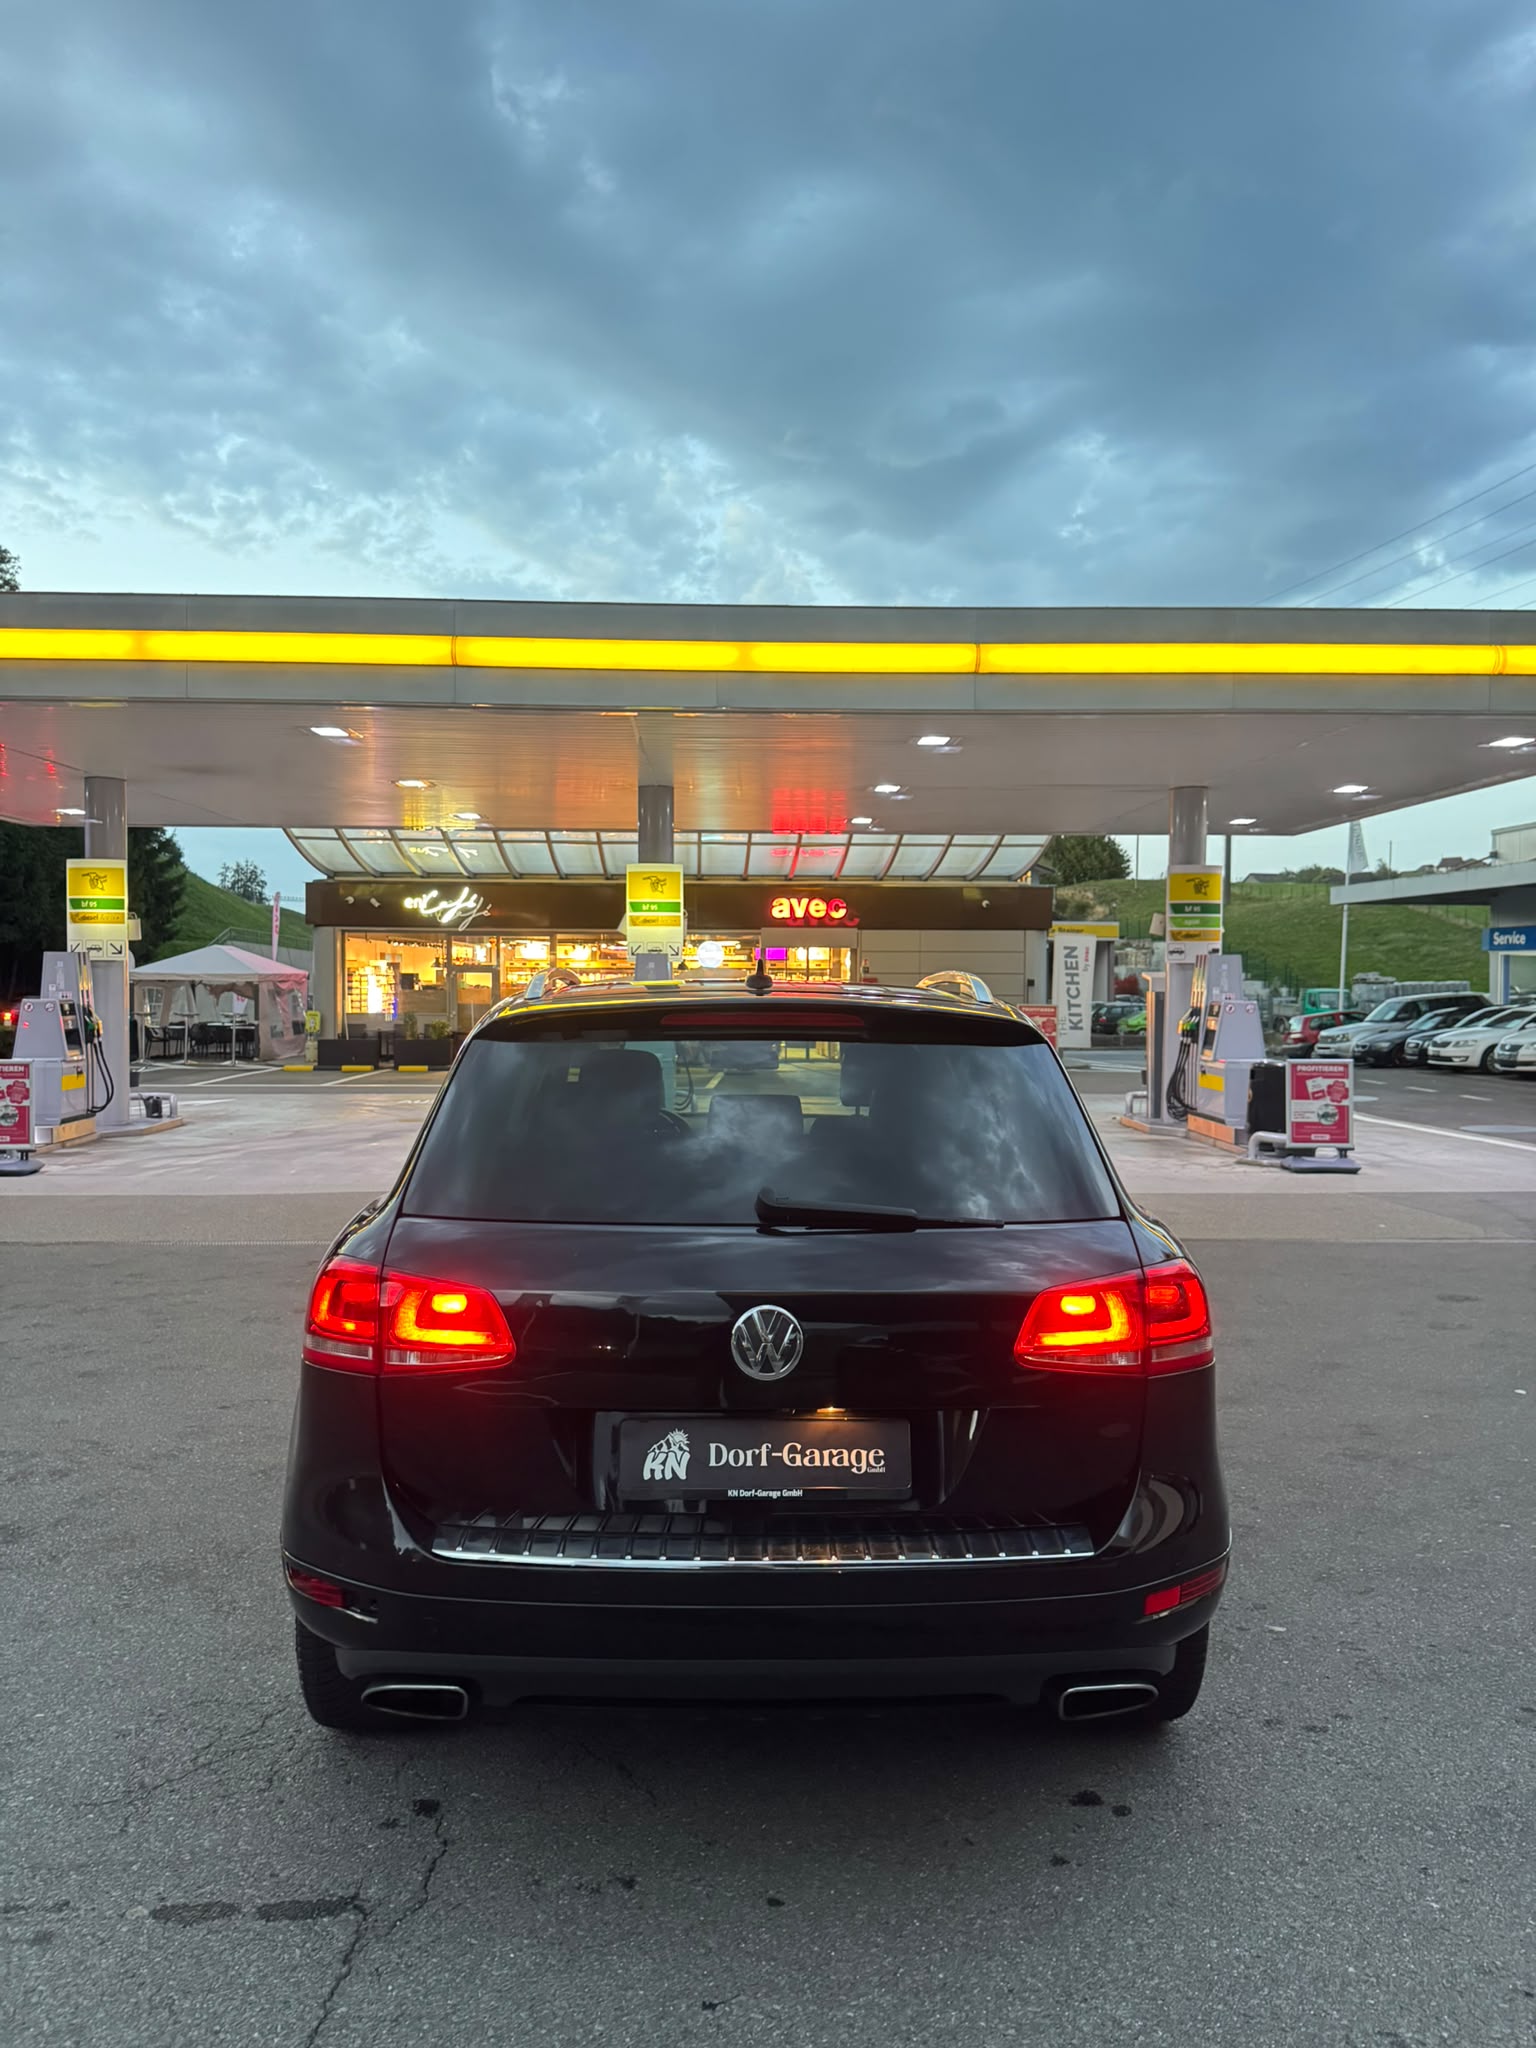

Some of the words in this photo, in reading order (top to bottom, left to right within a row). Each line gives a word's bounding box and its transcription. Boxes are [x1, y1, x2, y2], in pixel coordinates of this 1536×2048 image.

[771, 897, 847, 919] avec
[1493, 931, 1526, 945] Service
[1063, 945, 1084, 1031] KITCHEN
[643, 1451, 691, 1481] KN
[709, 1442, 885, 1475] Dorf-Garage
[728, 1489, 738, 1497] KN
[740, 1489, 781, 1498] Dorf-Garage
[782, 1489, 803, 1497] GmbH
